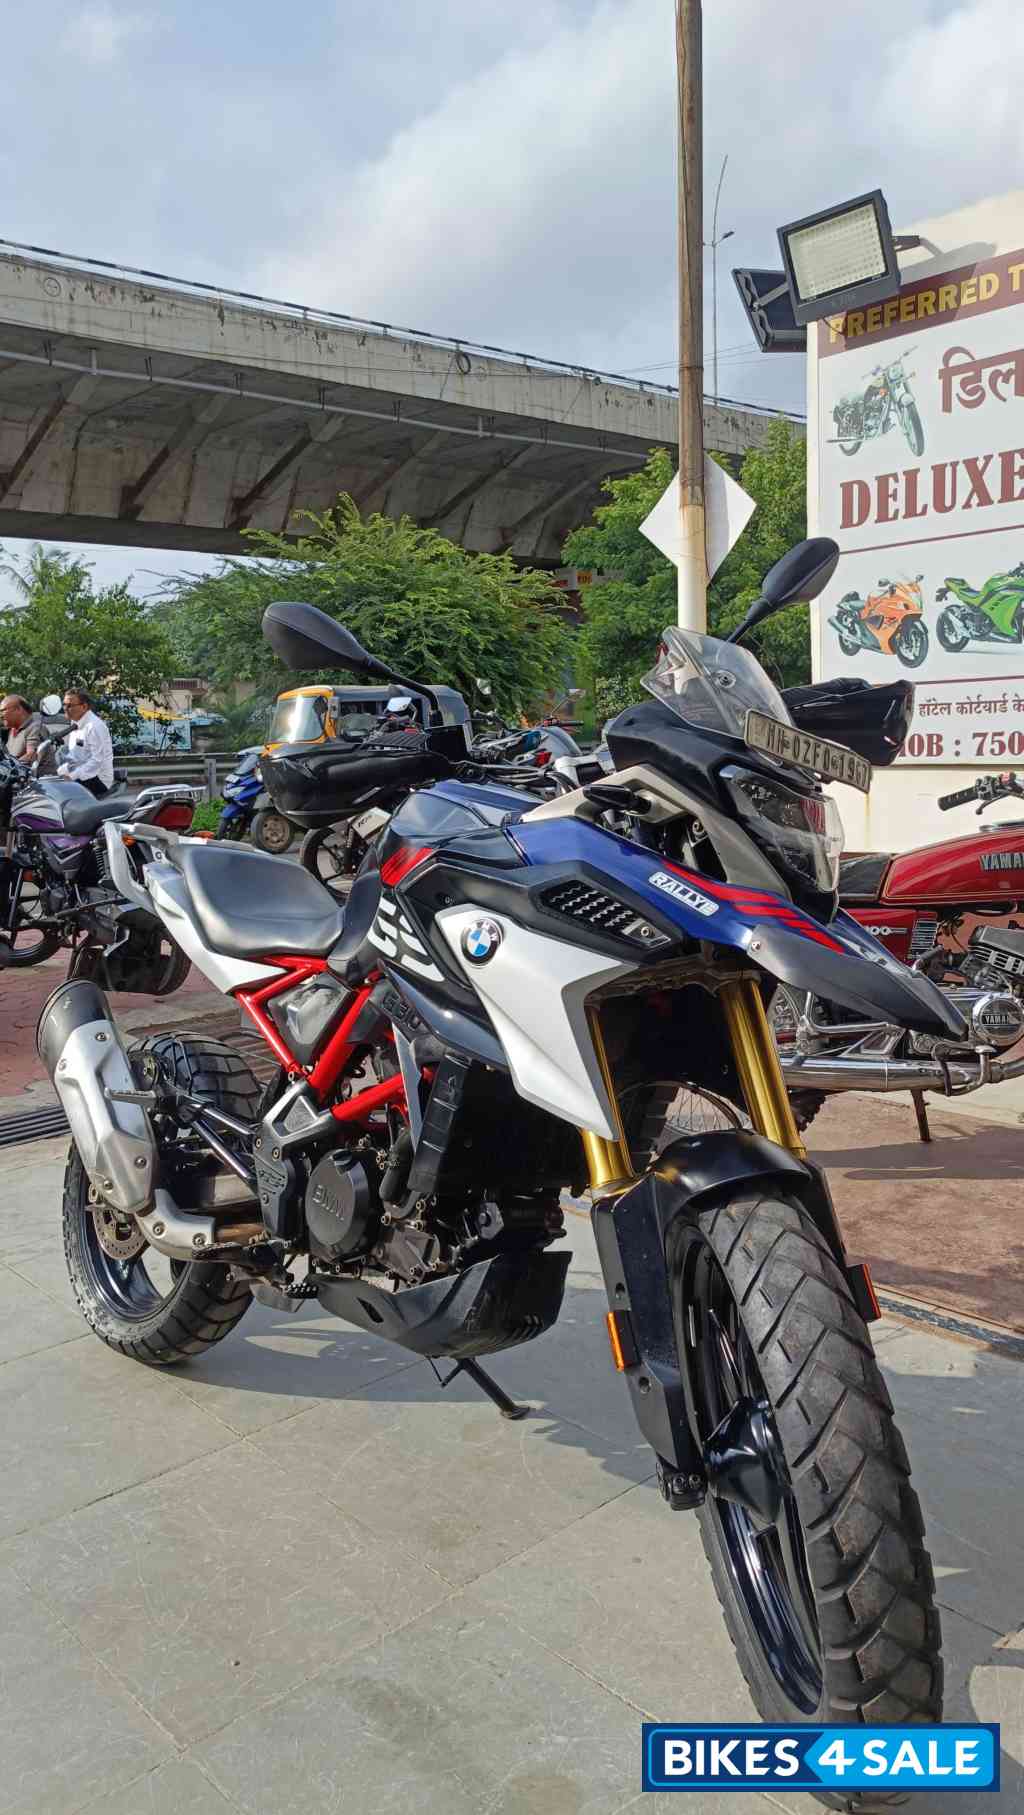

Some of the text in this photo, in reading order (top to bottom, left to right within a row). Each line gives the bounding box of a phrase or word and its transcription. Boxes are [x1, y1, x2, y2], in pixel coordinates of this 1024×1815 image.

[829, 272, 1000, 343] PREFERRED
[840, 448, 1024, 529] DELUXE
[898, 732, 943, 758] OB
[981, 852, 1024, 870] YAMA
